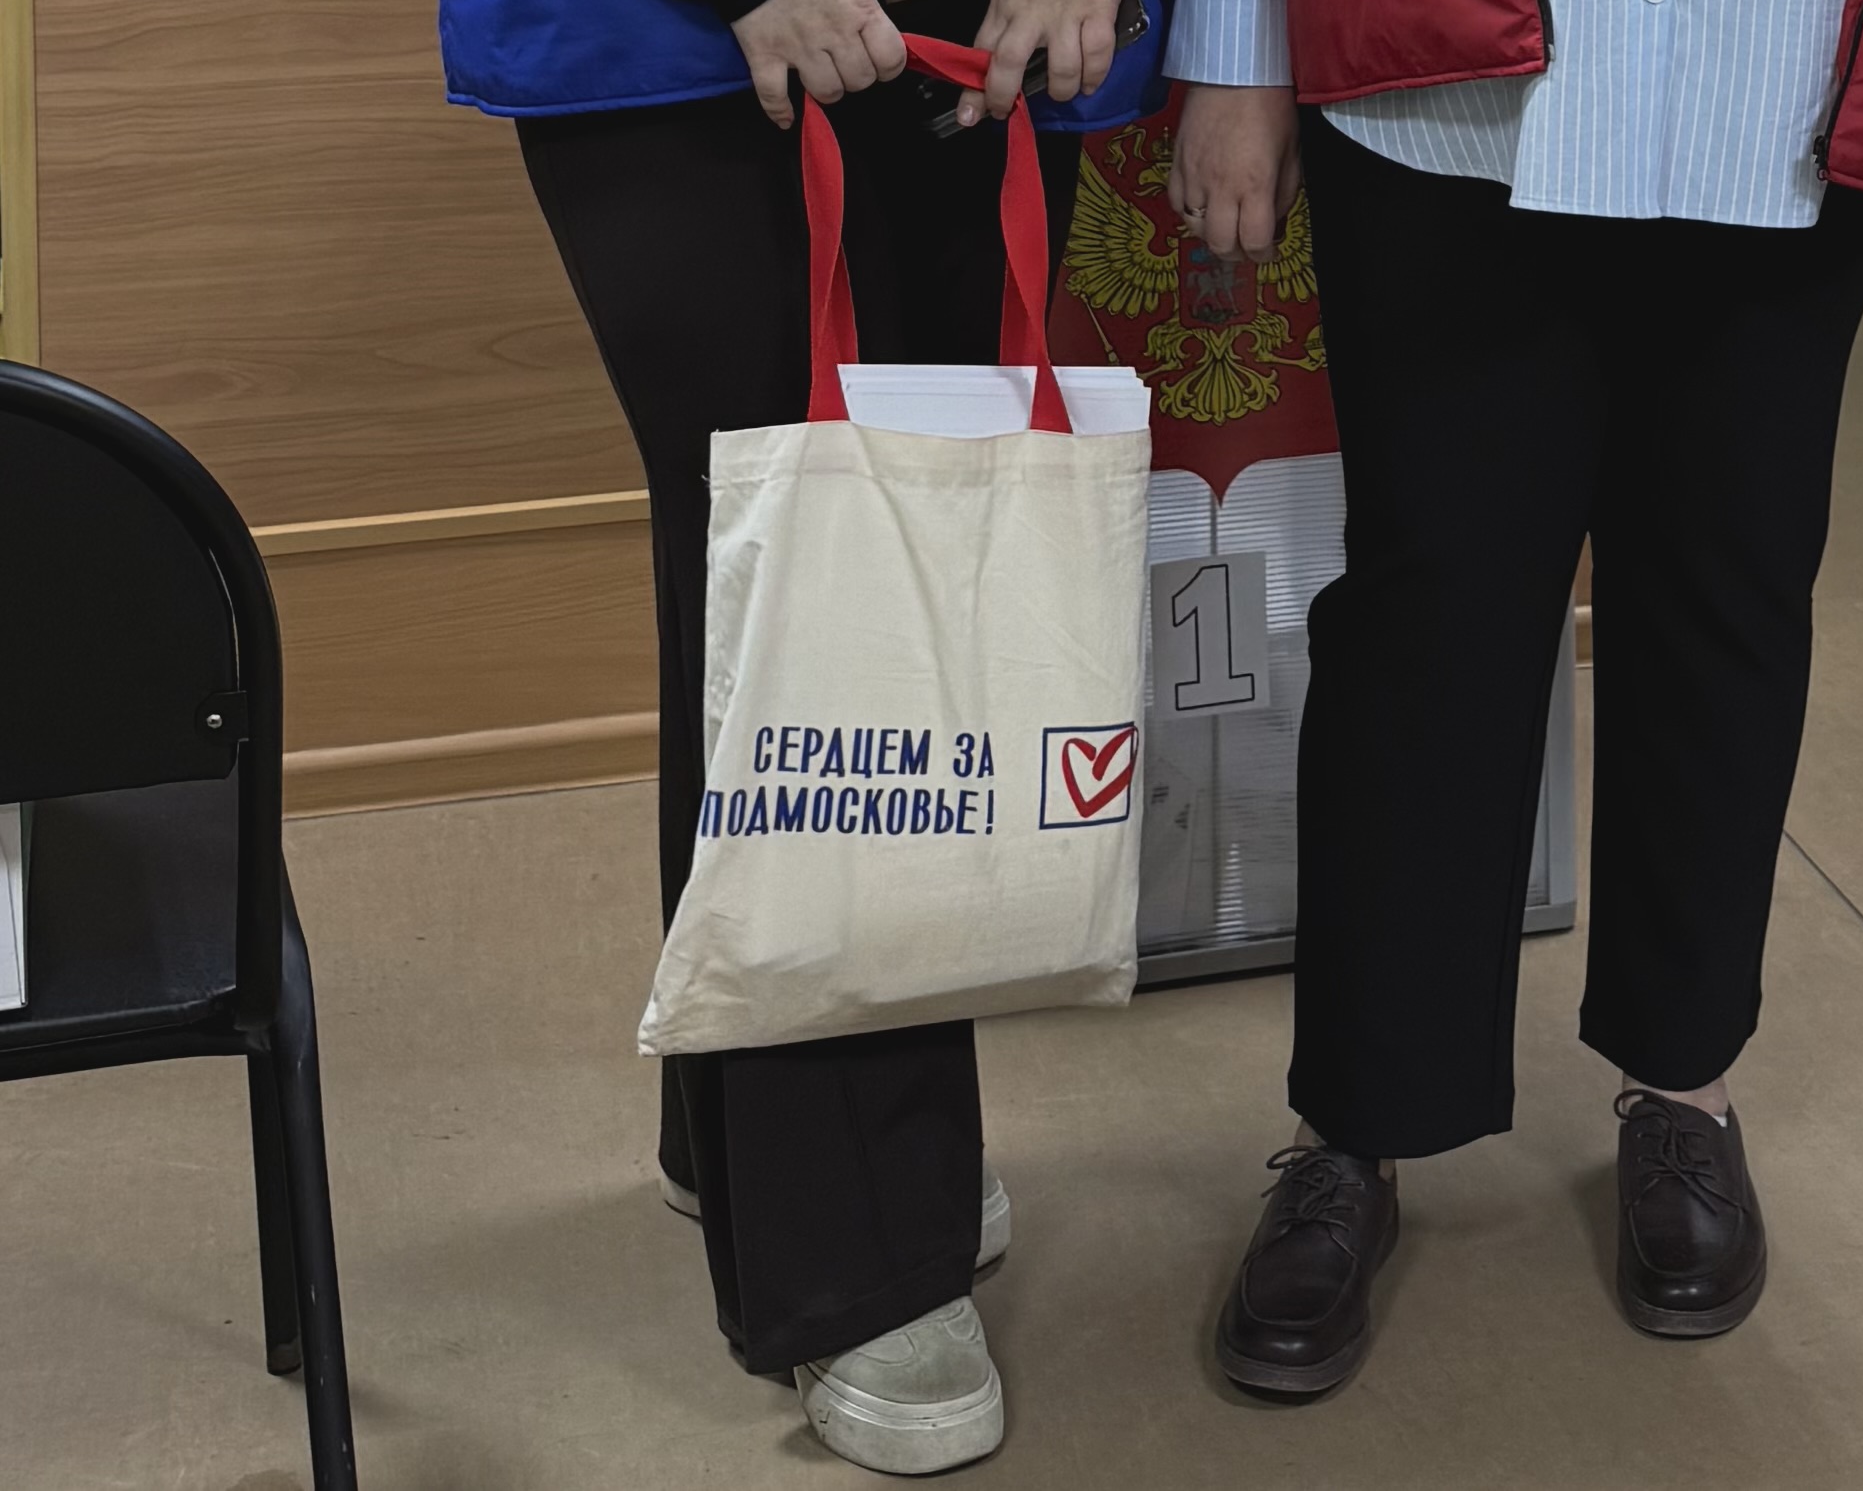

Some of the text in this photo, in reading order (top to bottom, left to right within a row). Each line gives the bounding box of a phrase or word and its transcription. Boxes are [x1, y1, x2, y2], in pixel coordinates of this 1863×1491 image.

[1172, 563, 1255, 711] 1
[753, 726, 995, 779] СЕРДЦЕМ ЗА
[701, 785, 995, 838] ПОДМОСКОВЬЕ!
